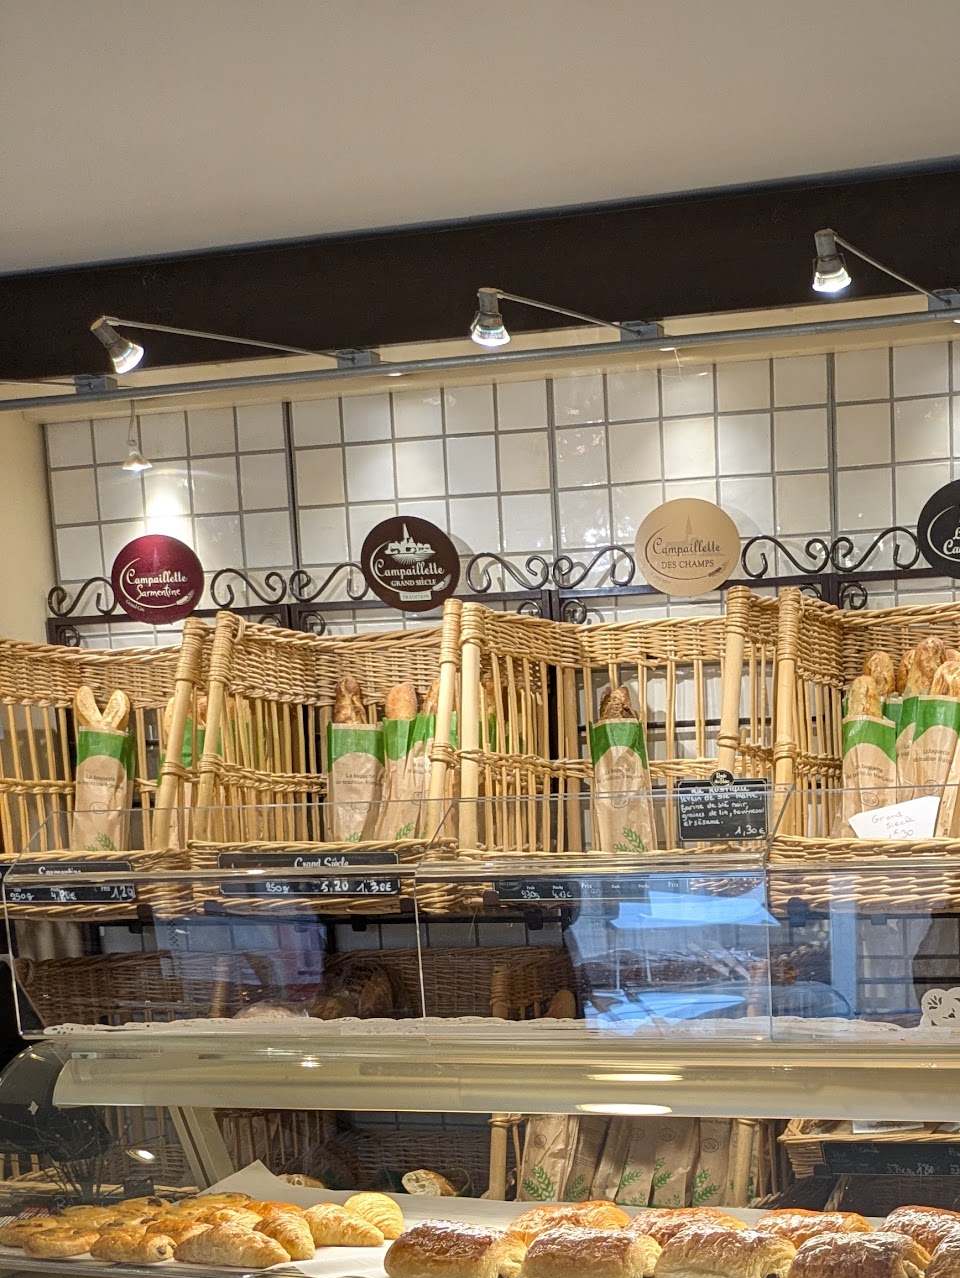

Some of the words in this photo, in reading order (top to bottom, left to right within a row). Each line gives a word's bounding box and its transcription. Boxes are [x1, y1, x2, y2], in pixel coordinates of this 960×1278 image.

[652, 537, 722, 557] Campaillette
[374, 558, 445, 580] Campaillette
[661, 560, 677, 569] DES
[679, 559, 715, 569] CHAMPS
[126, 568, 188, 587] Campaillette
[390, 579, 415, 587] GRAND
[136, 584, 182, 601] Sarmentine
